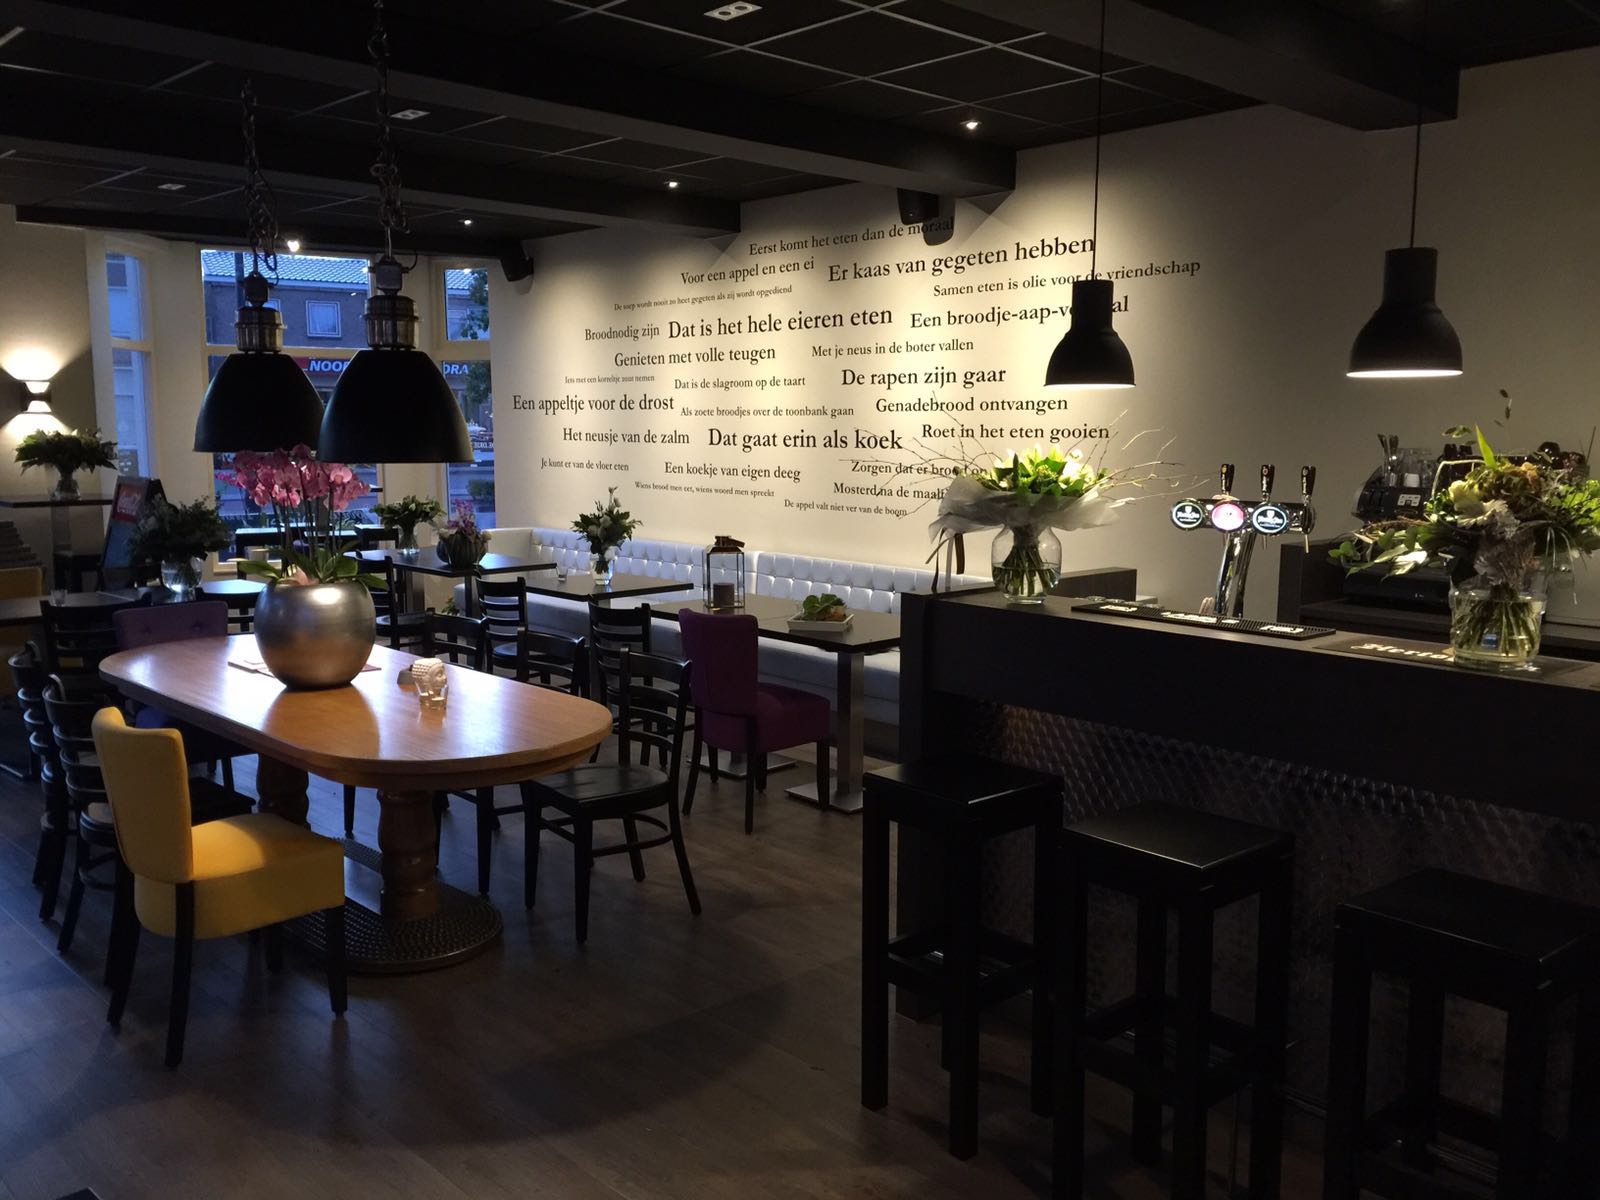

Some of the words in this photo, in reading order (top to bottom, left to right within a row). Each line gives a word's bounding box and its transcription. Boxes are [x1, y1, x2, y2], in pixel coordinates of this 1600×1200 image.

[750, 244, 777, 255] Eerst
[780, 240, 808, 252] komt
[812, 236, 829, 247] het
[833, 234, 858, 245] eten
[862, 228, 884, 241] dan
[888, 225, 904, 237] de
[829, 265, 848, 282] Er
[854, 263, 890, 279] kaas
[896, 260, 925, 274] van
[932, 249, 1009, 276] gegeten
[1016, 237, 1095, 260] hebben
[681, 272, 705, 284] Voor
[708, 272, 726, 282] een
[729, 264, 758, 282] appel
[762, 266, 776, 275] en
[780, 262, 800, 273] een
[804, 256, 814, 270] ei
[934, 285, 973, 296] Samen
[978, 283, 1003, 293] eten
[1009, 278, 1018, 290] is
[1023, 276, 1046, 288] olie
[1051, 275, 1081, 285] voor
[1106, 261, 1201, 280] vriendschap
[911, 314, 941, 328] Een
[948, 295, 1129, 328] broodje-aap-val
[585, 326, 639, 341] Broodnodig
[642, 324, 660, 339] zijn
[669, 321, 695, 338] Dat
[701, 319, 712, 336] is
[718, 318, 742, 335] het
[748, 314, 782, 333] hele
[788, 311, 844, 330] eieren
[851, 310, 892, 326] eten
[615, 352, 665, 367] Genieten
[669, 352, 691, 364] met
[696, 348, 725, 362] volle
[729, 349, 775, 365] teugen
[812, 346, 832, 357] Met
[835, 345, 844, 359] je
[847, 347, 872, 355] neus
[876, 343, 885, 354] in
[889, 342, 902, 353] de
[906, 342, 935, 352] boter
[939, 339, 974, 351] vallen
[675, 379, 689, 389] Dat
[692, 379, 698, 389] is
[700, 378, 710, 388] de
[713, 378, 753, 391] slagroom
[756, 380, 767, 390] op
[770, 376, 781, 387] de
[784, 378, 805, 386] taart
[842, 370, 865, 385] De
[871, 373, 918, 390] rapen
[924, 367, 956, 388] zijn
[963, 370, 1006, 389] gaar
[514, 395, 535, 410] Een
[539, 395, 584, 415] appeltje
[588, 400, 616, 410] voor
[620, 394, 635, 410] de
[639, 394, 674, 410] drost
[681, 407, 692, 416] Als
[717, 406, 751, 419] broodjes
[773, 406, 783, 416] de
[786, 406, 828, 416] toonbank
[831, 408, 854, 419] gaan
[876, 397, 974, 412] Genadebrood
[980, 400, 1068, 415] ontvangen
[564, 428, 582, 441] Het
[586, 429, 618, 446] neusje
[622, 434, 640, 443] van
[644, 430, 657, 443] de
[661, 430, 690, 444] zalm
[709, 428, 737, 446] Dat
[742, 434, 777, 453] gaat
[783, 430, 816, 448] erin
[824, 430, 848, 448] als
[855, 430, 902, 449] koek
[922, 424, 955, 438] Roet
[960, 424, 975, 438] in
[980, 424, 1004, 438] het
[1010, 428, 1044, 438] eten
[1050, 424, 1109, 443] gooien
[666, 462, 683, 474] Een
[687, 463, 718, 478] koekje
[721, 468, 738, 476] van
[742, 465, 770, 481] eigen
[774, 466, 801, 483] deeg
[851, 460, 892, 476] Zorgen
[833, 482, 877, 496] Mosterd
[880, 487, 893, 496] na
[896, 486, 910, 498] de
